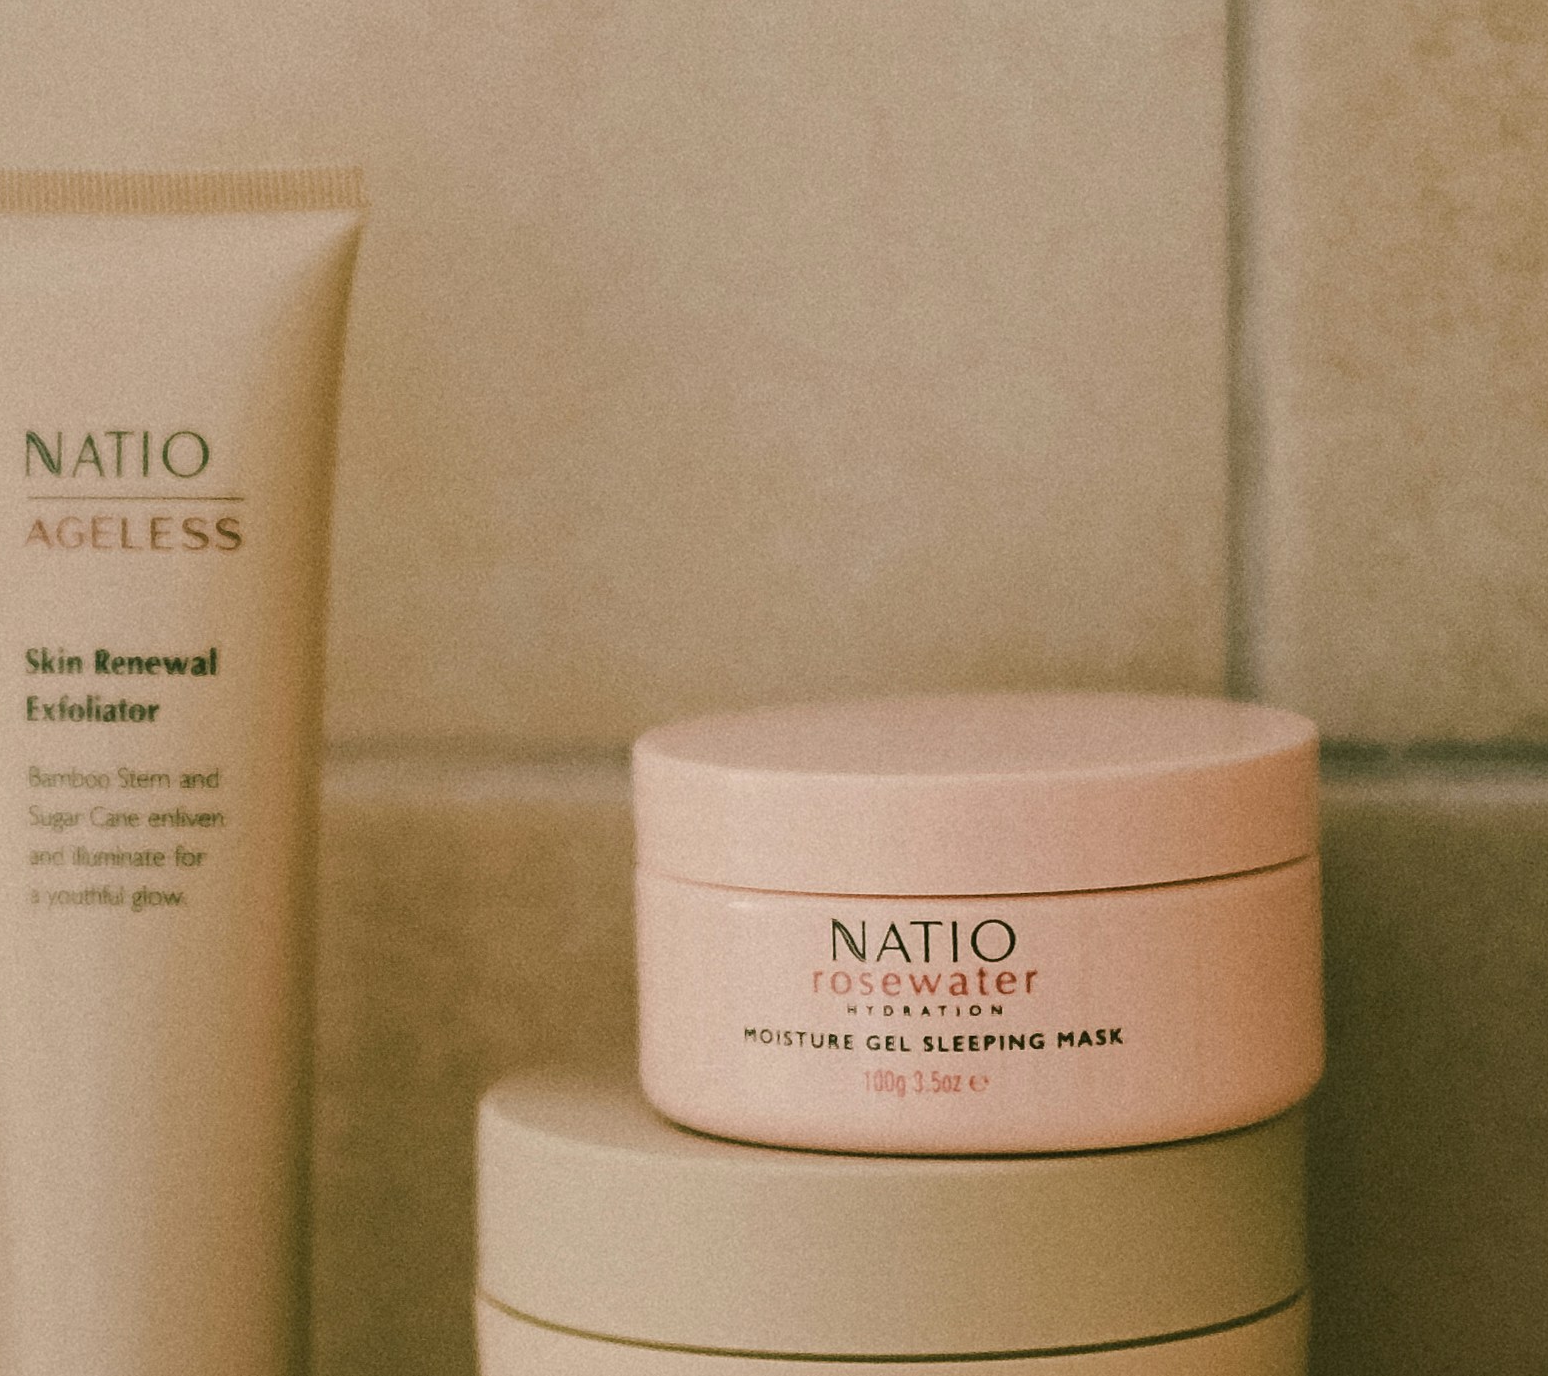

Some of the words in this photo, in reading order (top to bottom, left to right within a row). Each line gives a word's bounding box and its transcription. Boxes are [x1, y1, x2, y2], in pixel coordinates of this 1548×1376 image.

[24, 429, 210, 478] NATIO
[24, 515, 245, 551] AGELESS
[24, 646, 83, 674] Skin
[94, 646, 219, 676] Renewal
[25, 694, 161, 723] Exfoliator
[29, 765, 110, 788] Bamboo
[117, 766, 171, 788] Stem
[180, 767, 220, 789] and
[28, 804, 83, 832] Sugar
[90, 805, 140, 827] Cane
[148, 807, 224, 828] enliven
[30, 845, 64, 866] and
[72, 845, 166, 867] illuminate
[175, 844, 208, 867] for
[831, 918, 1017, 963] NATIO
[812, 966, 1039, 997] rosewater
[847, 1004, 1004, 1017] HYDRATION
[744, 1026, 854, 1051] MOISTURE
[866, 1034, 911, 1053] GEL
[923, 1031, 1046, 1053] SLEEPING
[1057, 1027, 1124, 1048] MASK
[864, 1069, 906, 1099] 100g
